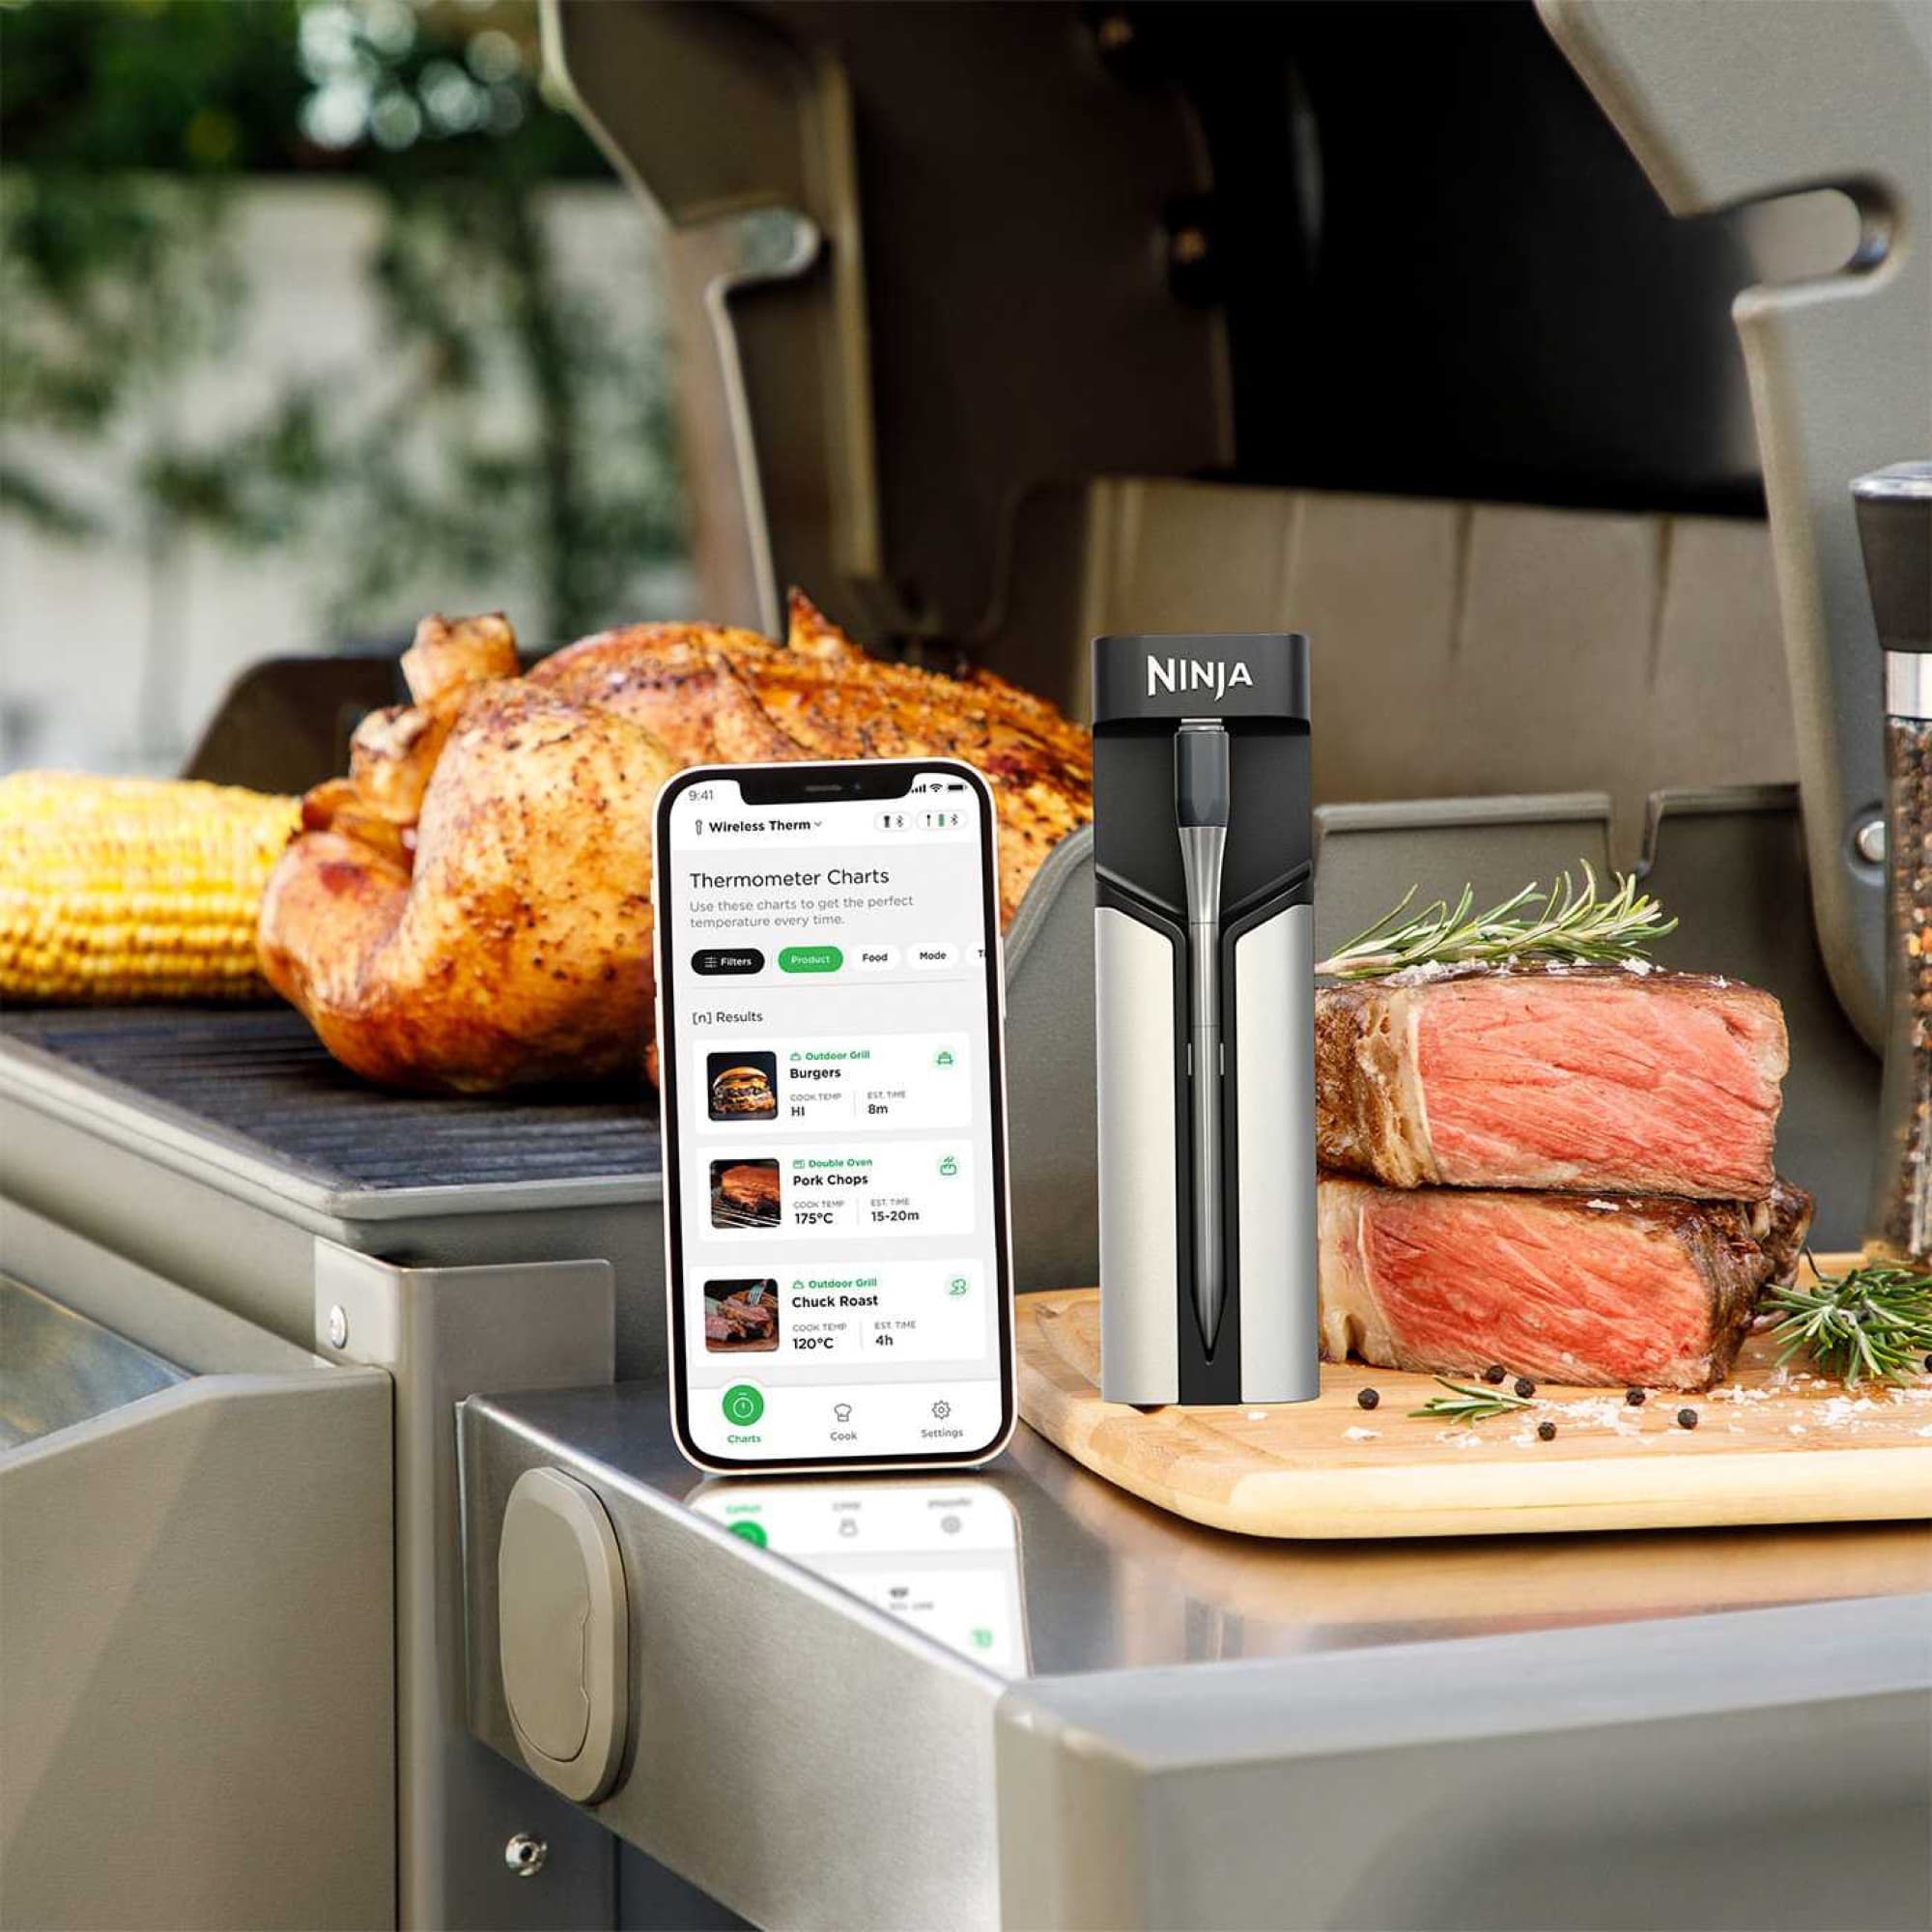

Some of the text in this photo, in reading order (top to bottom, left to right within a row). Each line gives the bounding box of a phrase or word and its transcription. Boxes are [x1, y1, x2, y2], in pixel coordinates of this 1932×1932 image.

[1147, 655, 1254, 701] NINJA
[689, 789, 714, 801] 9:41
[708, 819, 810, 833] Wireless Therm
[690, 867, 890, 889] Thermometer Charts
[690, 895, 914, 913] Use these charts to get the perfect
[690, 914, 844, 929] temperature every time.
[721, 956, 752, 967] Filters
[790, 954, 831, 964] Product
[863, 952, 889, 962] Food
[920, 951, 947, 961] Mode
[692, 1010, 763, 1025] [n] Results
[806, 1050, 870, 1061] Outdoor Grill
[789, 1066, 841, 1080] Burgers
[790, 1093, 841, 1102] COOK TEMP
[886, 1091, 906, 1099] TIME
[791, 1106, 805, 1117] HI
[867, 1103, 889, 1115] 8m
[809, 1158, 872, 1169] Double Oven
[793, 1174, 868, 1188] Pork Chops
[871, 1199, 887, 1208] EST.
[795, 1212, 834, 1225] 175°C
[871, 1209, 920, 1222] 15-20m
[809, 1278, 877, 1290] Outdoor Grill
[792, 1295, 878, 1308] Chuck Roast
[792, 1322, 847, 1333] COOK TEMP
[874, 1321, 917, 1330] EST. TIME
[792, 1337, 835, 1350] 120°C
[875, 1335, 894, 1347] 4h
[727, 1434, 761, 1444] Charts
[830, 1431, 858, 1442] Cook
[921, 1429, 963, 1440] Settings
